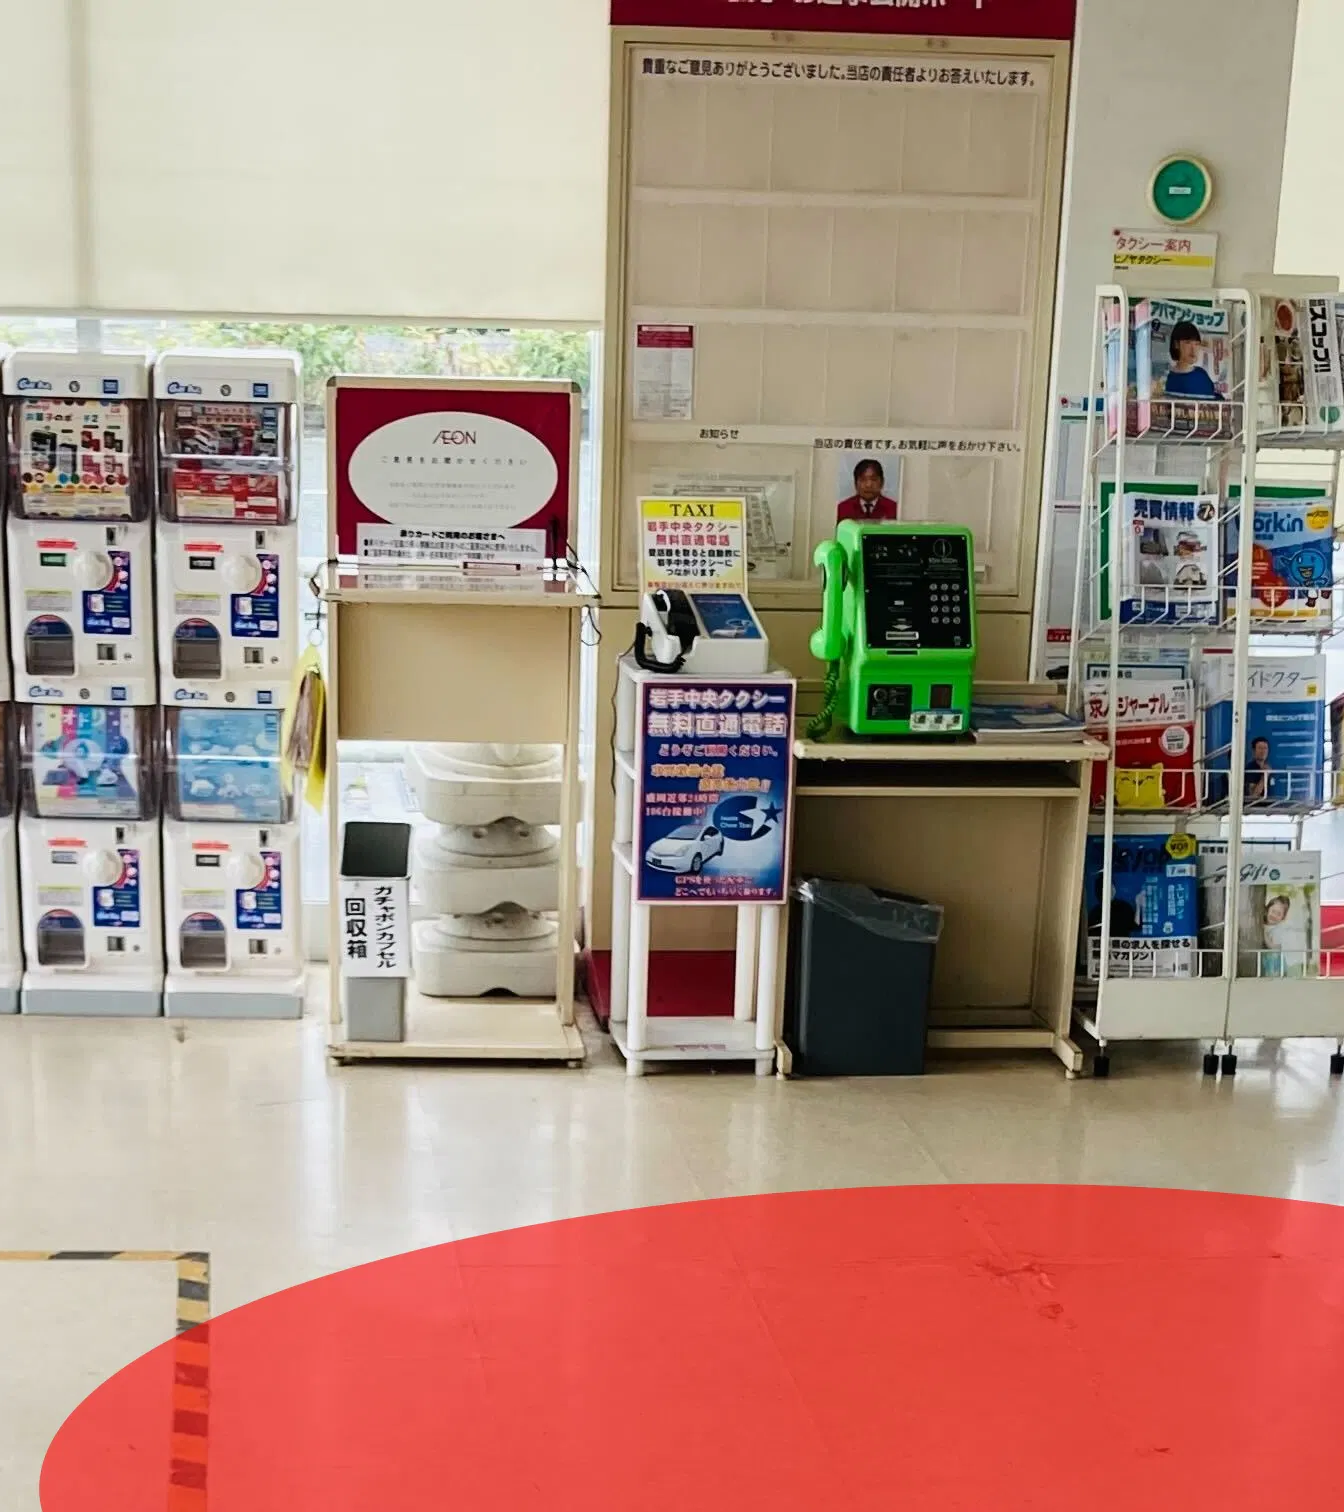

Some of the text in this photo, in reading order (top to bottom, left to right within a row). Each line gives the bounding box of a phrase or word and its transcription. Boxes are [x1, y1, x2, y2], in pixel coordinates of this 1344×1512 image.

[641, 56, 1035, 87] 貴重なご意見ありがとうございました。当店の責任者よりお答えいたします。
[1116, 237, 1191, 253] タクシー案内
[1113, 254, 1172, 265] ヒノヤタクシー
[1150, 301, 1225, 327] アパマンショップ
[699, 428, 739, 440] お知らせ
[669, 503, 716, 518] TAXI
[647, 521, 739, 533] 岩手中央タクシー
[1244, 511, 1304, 534] orkin
[656, 534, 730, 547] 無料直通電話
[665, 568, 720, 578] つながります。
[1244, 670, 1319, 689] イドクター
[649, 687, 786, 710] 岩手中央タクシー
[648, 712, 788, 738] 無料直通電話
[345, 898, 368, 959] 回収箱
[373, 886, 397, 969] ガチャポンカプセル
